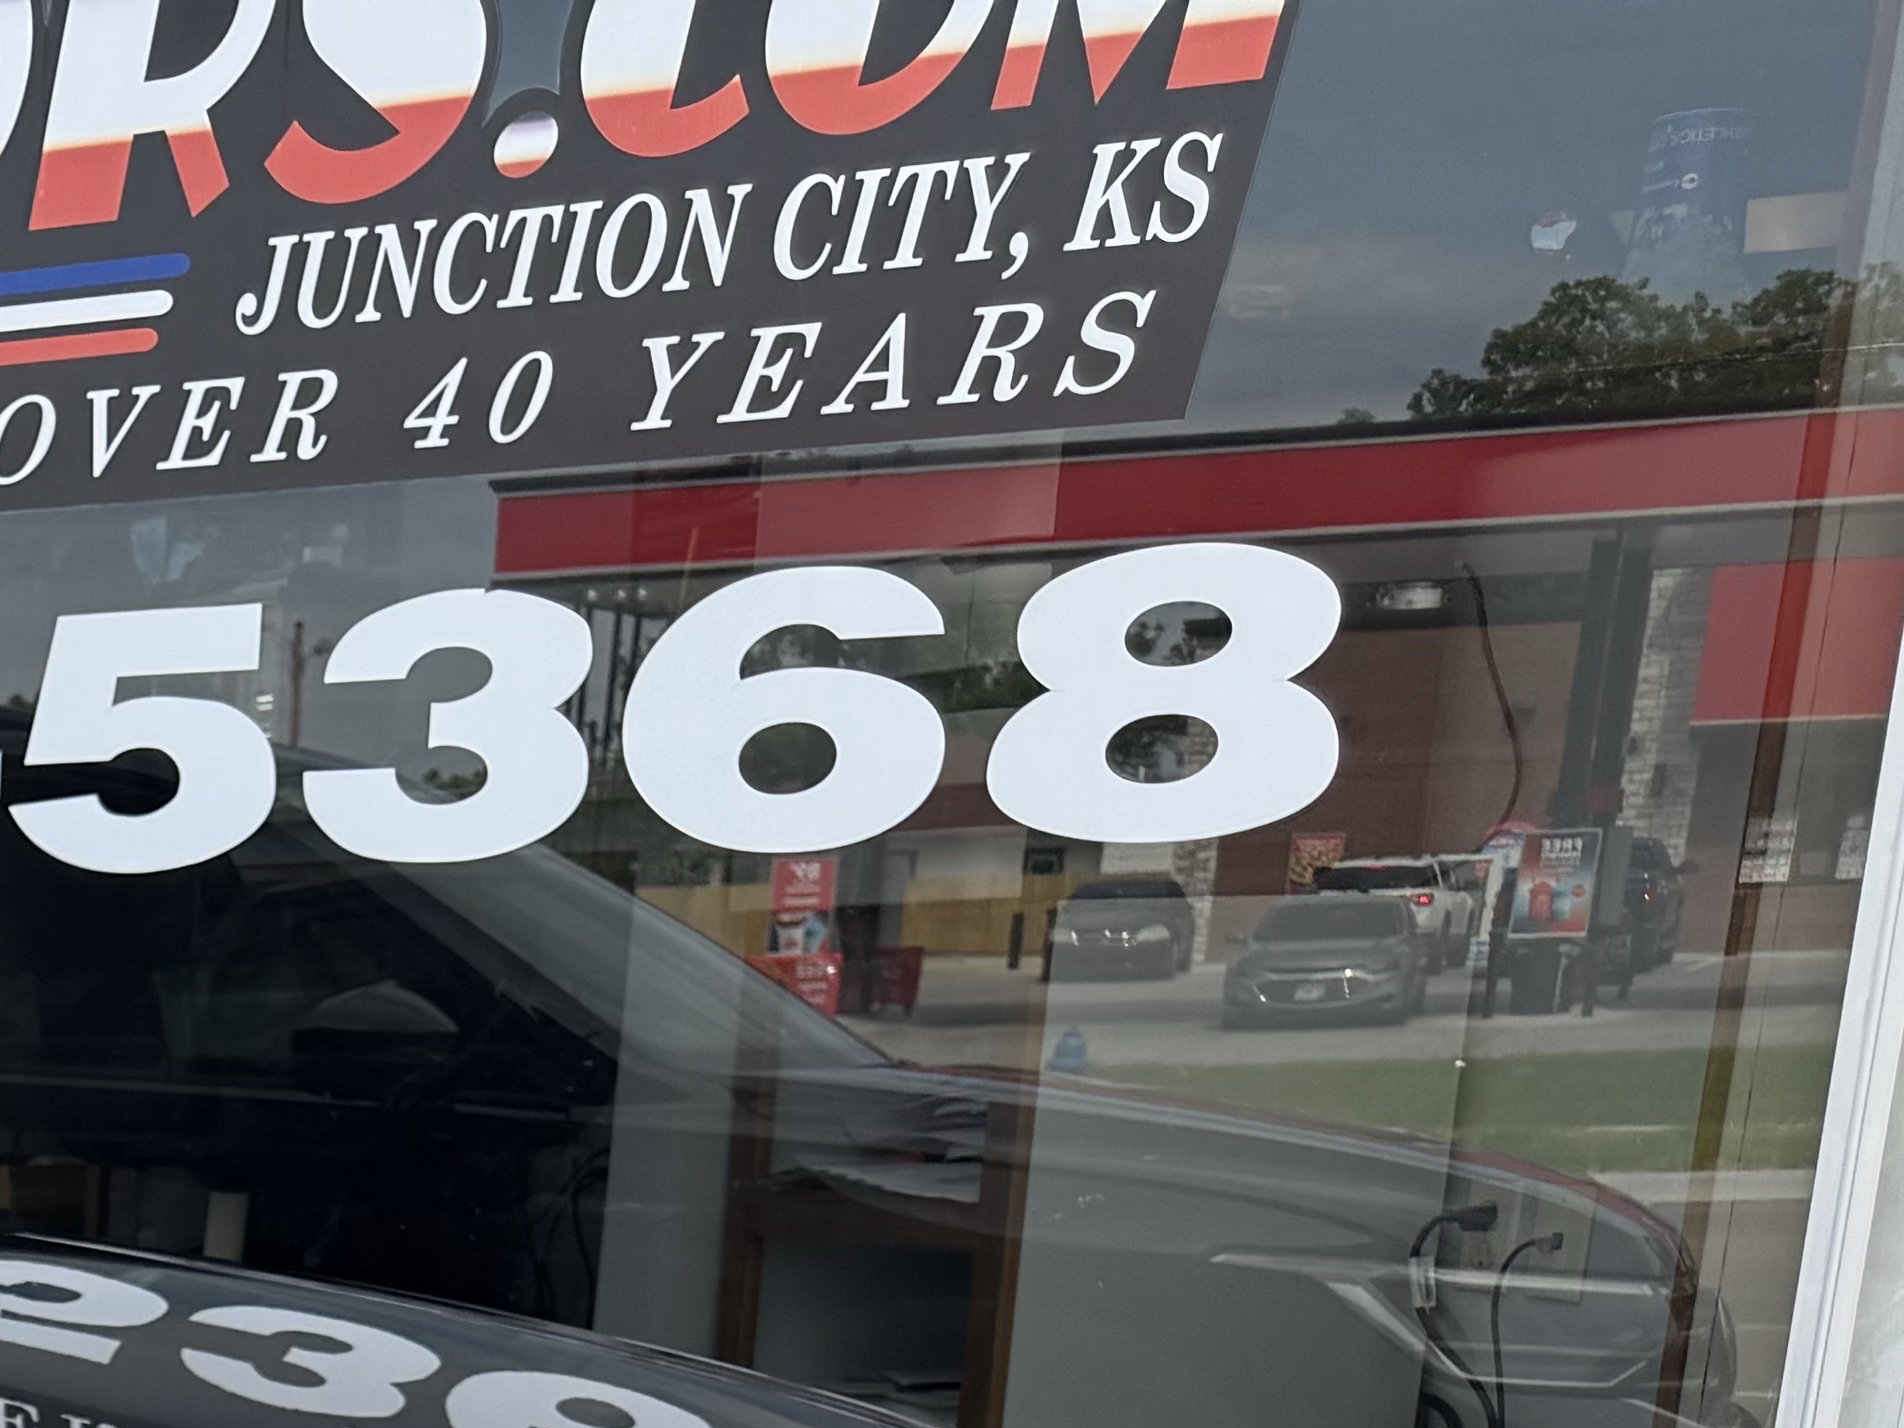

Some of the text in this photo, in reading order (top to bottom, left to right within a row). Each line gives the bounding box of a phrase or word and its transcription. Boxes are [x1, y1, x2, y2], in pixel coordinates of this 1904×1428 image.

[235, 132, 1223, 335] JUNCTION CITY, KS
[404, 350, 554, 450] 40
[631, 290, 1156, 432] YEARS
